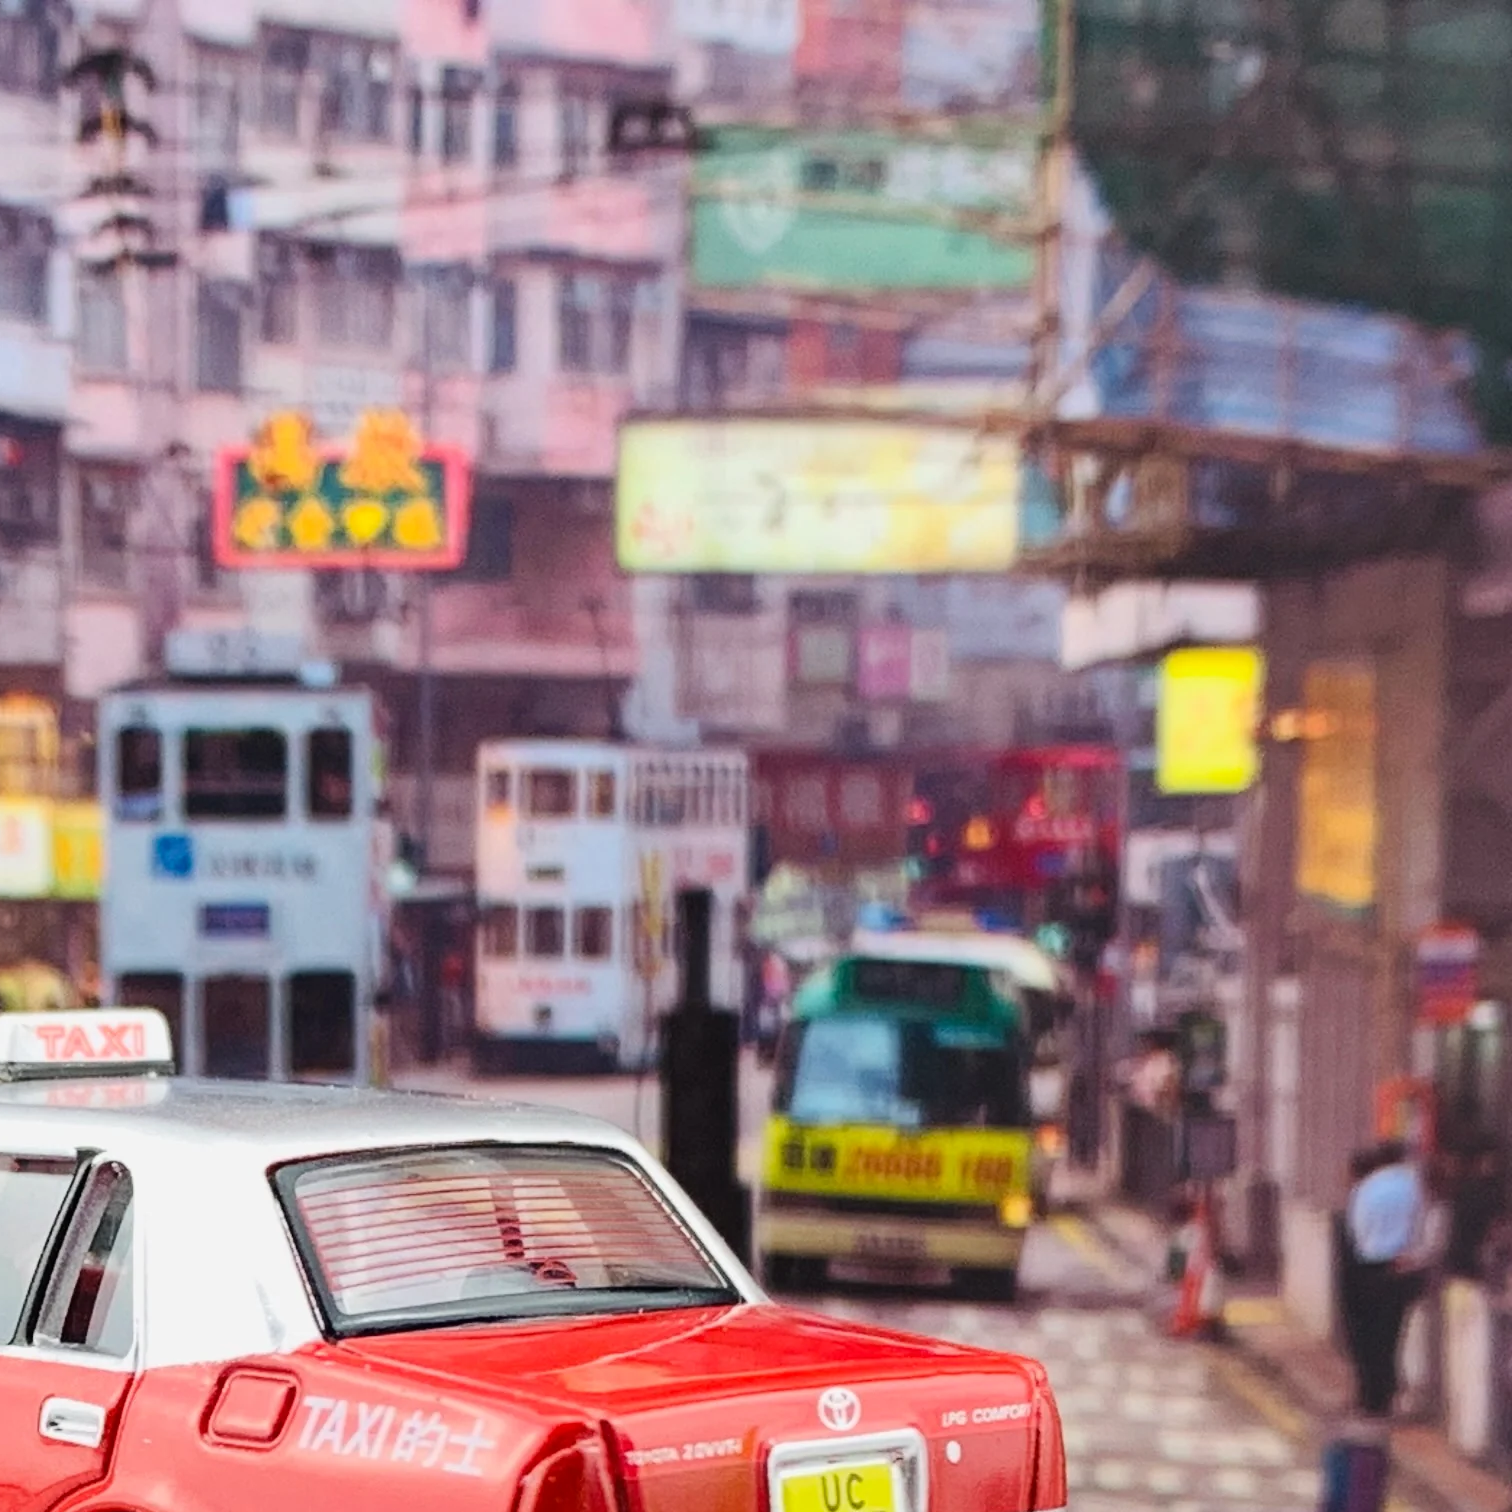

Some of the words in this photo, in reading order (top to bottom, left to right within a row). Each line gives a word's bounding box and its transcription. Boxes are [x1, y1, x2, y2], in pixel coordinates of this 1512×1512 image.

[36, 1024, 145, 1060] TAXI
[297, 1395, 396, 1459] TAXI
[390, 1409, 497, 1477] 的士
[821, 1473, 866, 1512] UC
